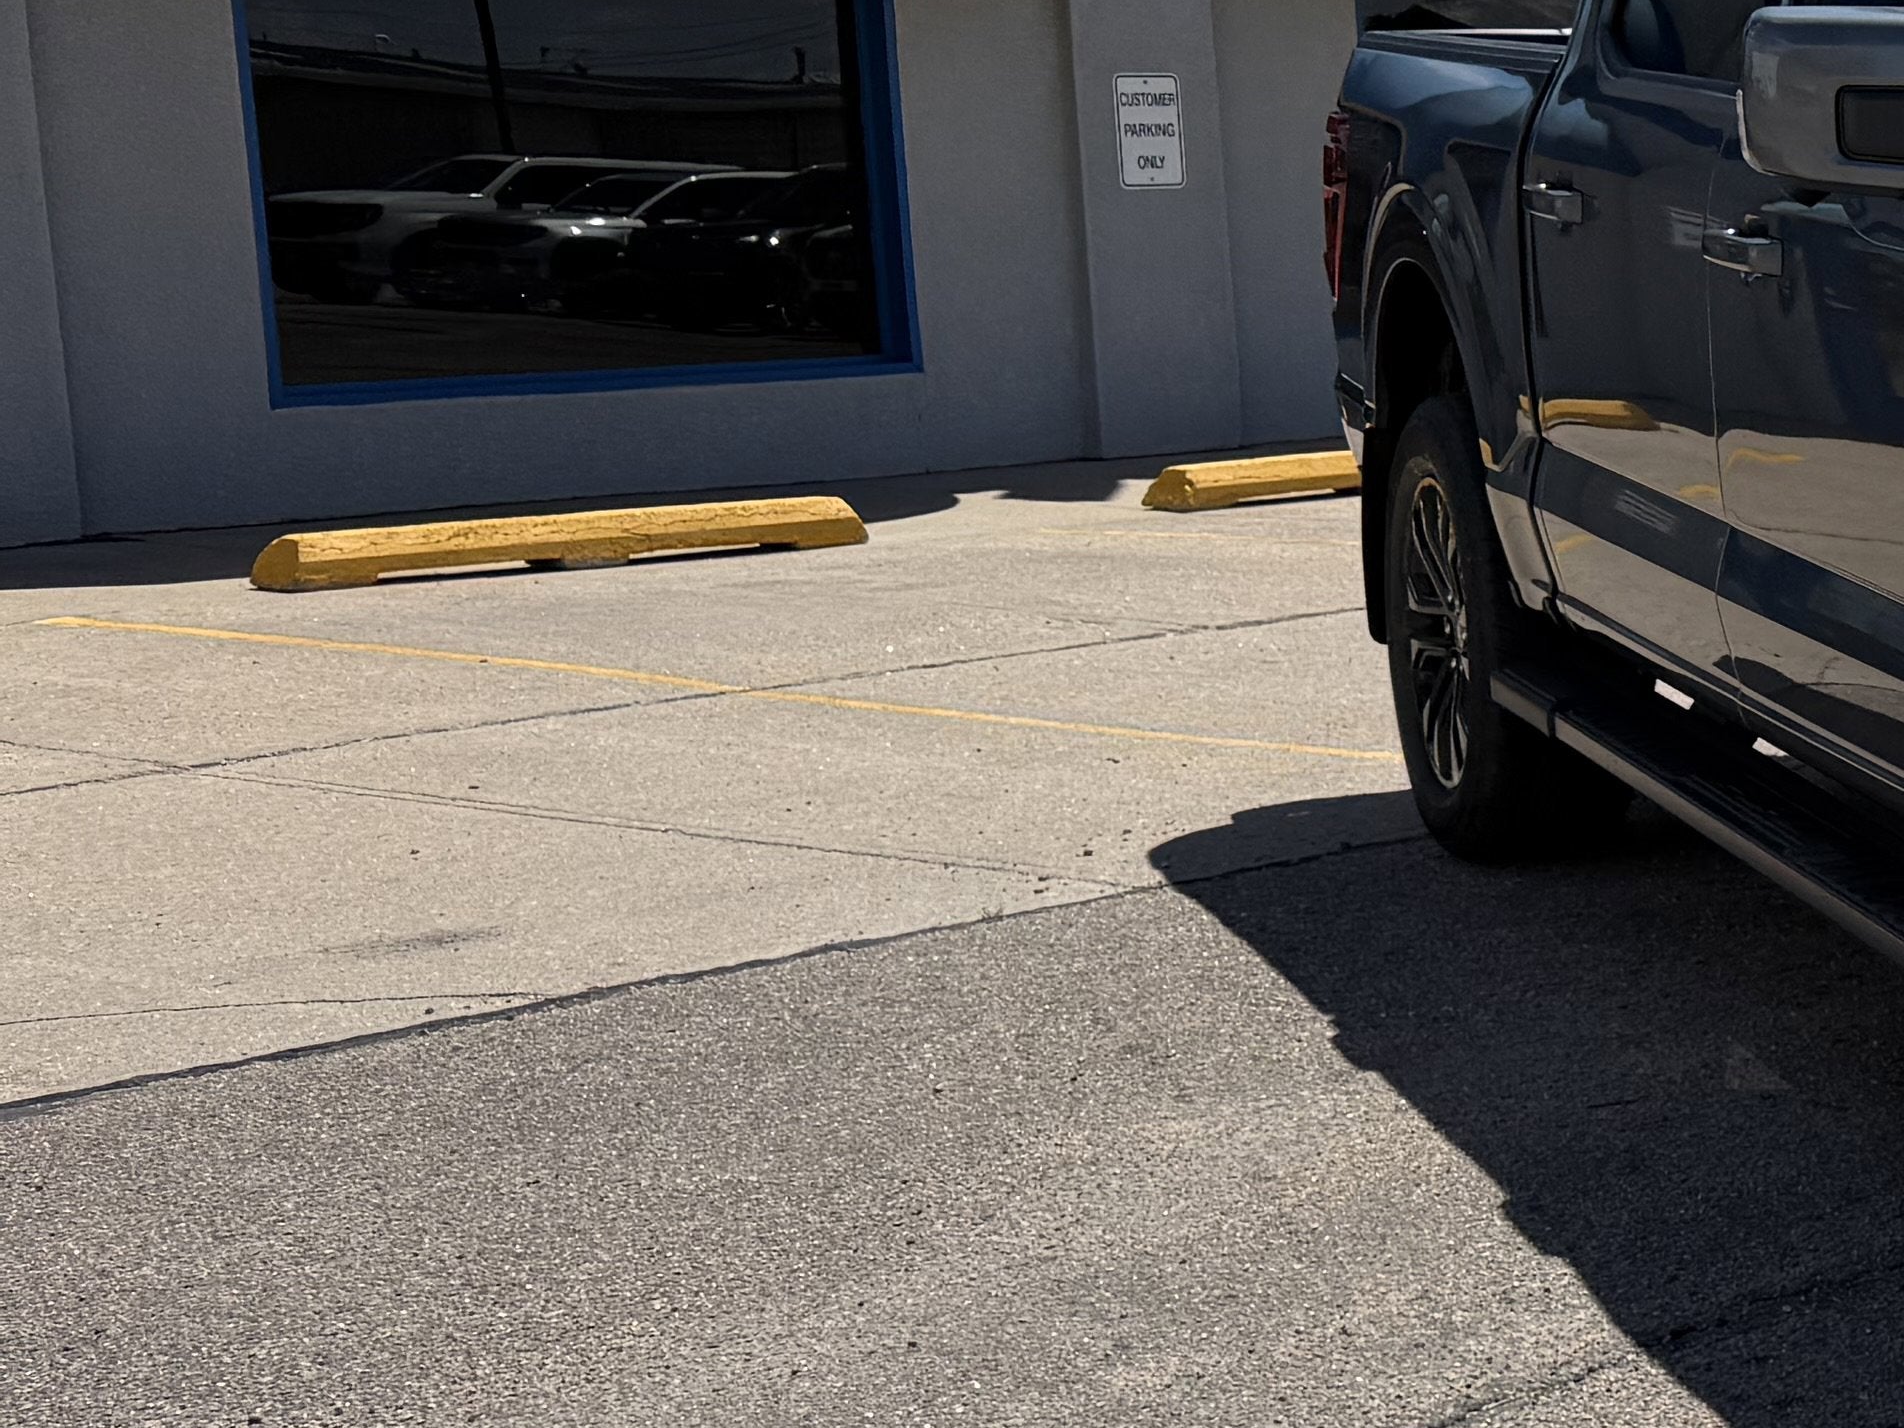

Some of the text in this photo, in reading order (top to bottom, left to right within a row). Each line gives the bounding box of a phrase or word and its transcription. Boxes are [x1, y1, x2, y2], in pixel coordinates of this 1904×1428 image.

[1119, 91, 1176, 107] CUSTOMER
[1123, 122, 1176, 138] PARKING
[1137, 155, 1166, 170] ONLY
